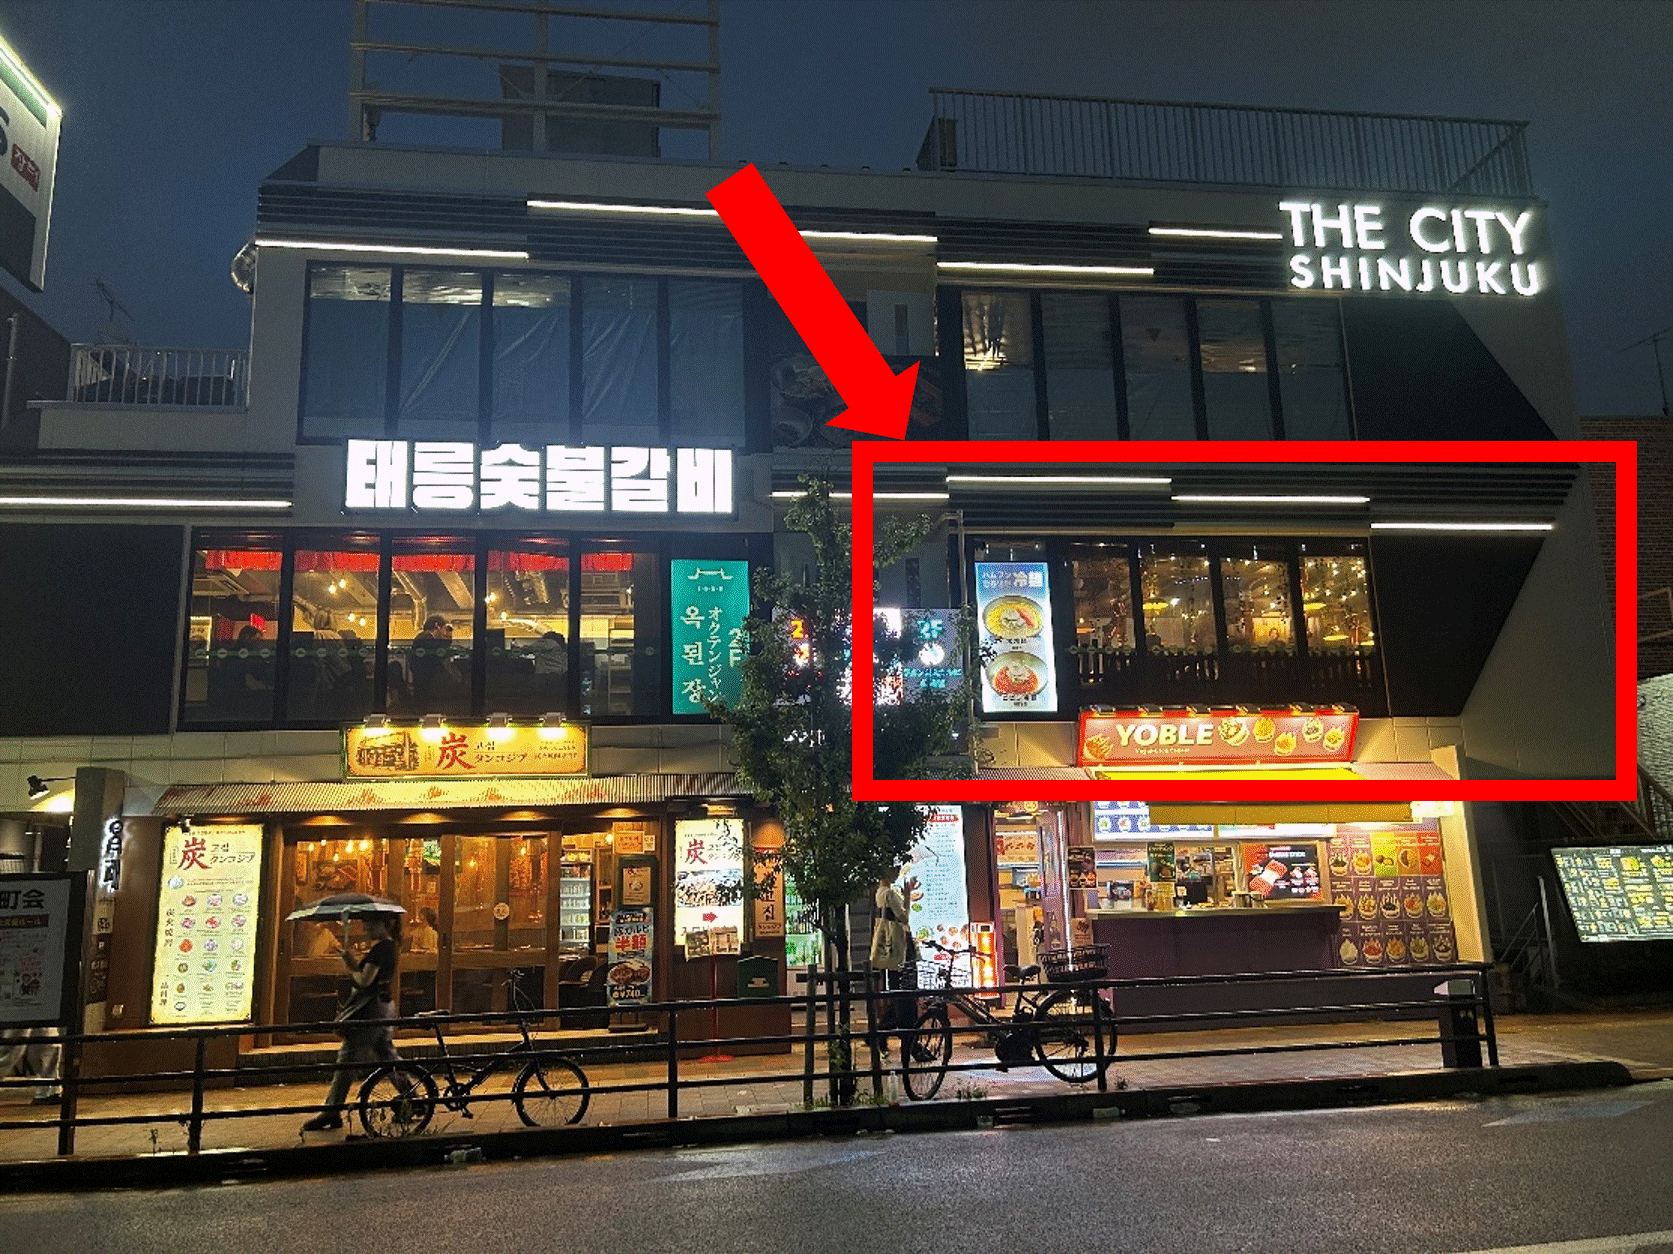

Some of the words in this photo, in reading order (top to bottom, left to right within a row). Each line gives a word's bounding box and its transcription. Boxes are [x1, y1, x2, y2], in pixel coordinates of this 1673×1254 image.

[1279, 201, 1386, 250] THE
[1408, 206, 1532, 255] CITY
[1289, 254, 1540, 296] SHINJUKU
[345, 439, 733, 515] 태릉숯불갈비
[680, 605, 706, 703] 옥된장
[435, 731, 477, 770] 炭
[1115, 724, 1214, 746] YOBLE
[178, 836, 212, 870] 炭
[684, 838, 708, 864] 炭
[616, 934, 647, 951] 半額
